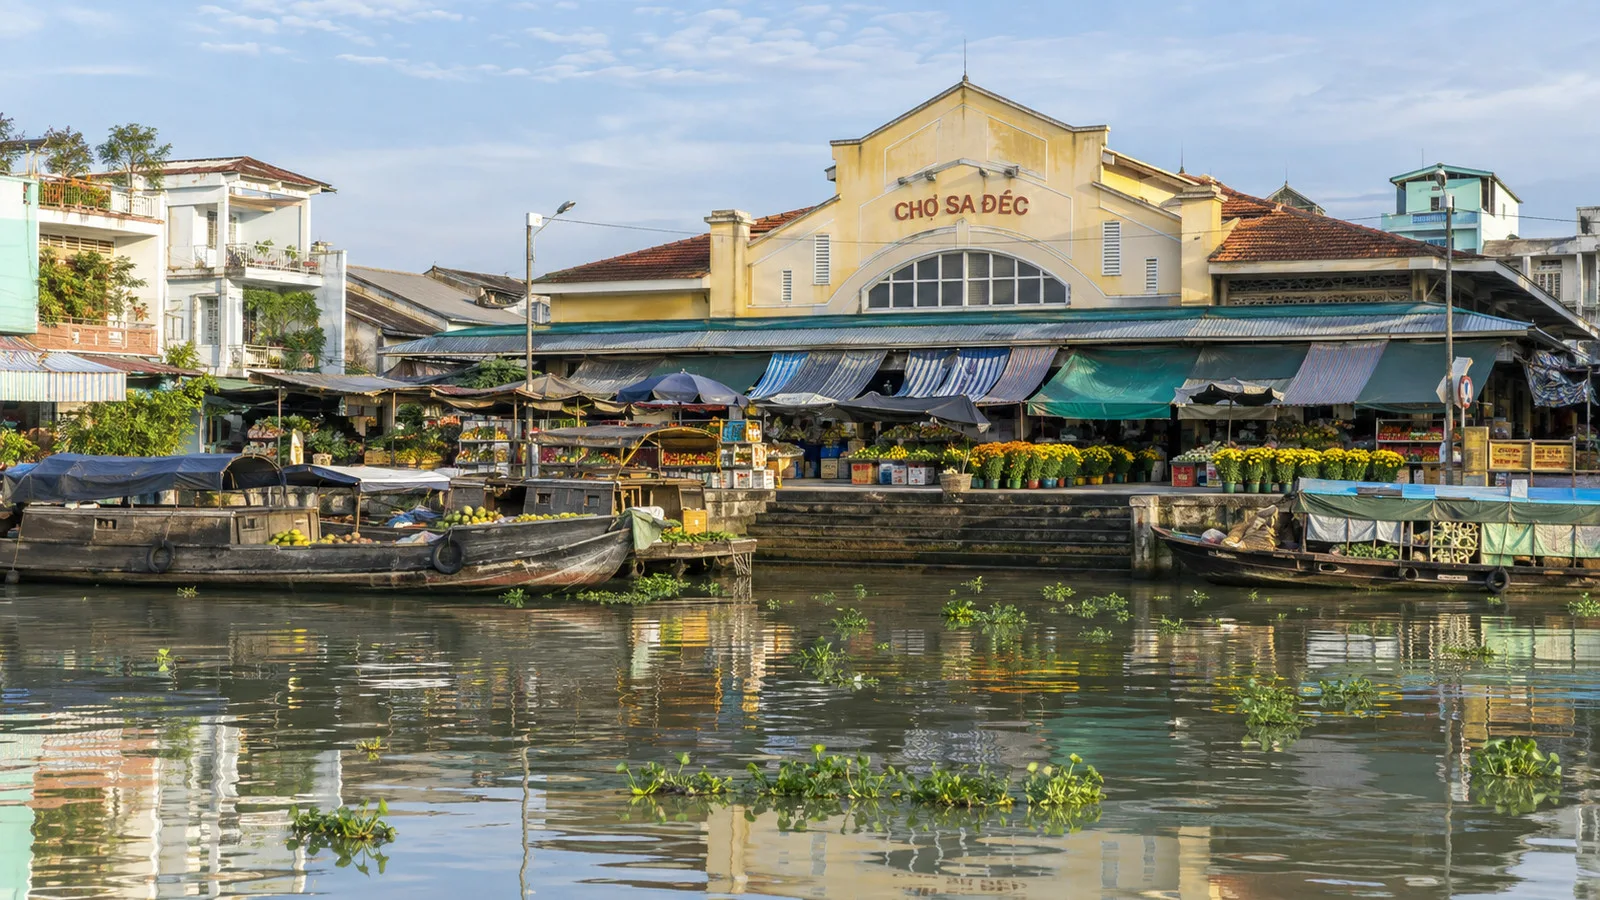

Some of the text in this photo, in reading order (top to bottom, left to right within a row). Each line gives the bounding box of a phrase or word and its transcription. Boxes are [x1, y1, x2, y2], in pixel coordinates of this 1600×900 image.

[894, 189, 1029, 221] CHỢ SA ĐÉC
